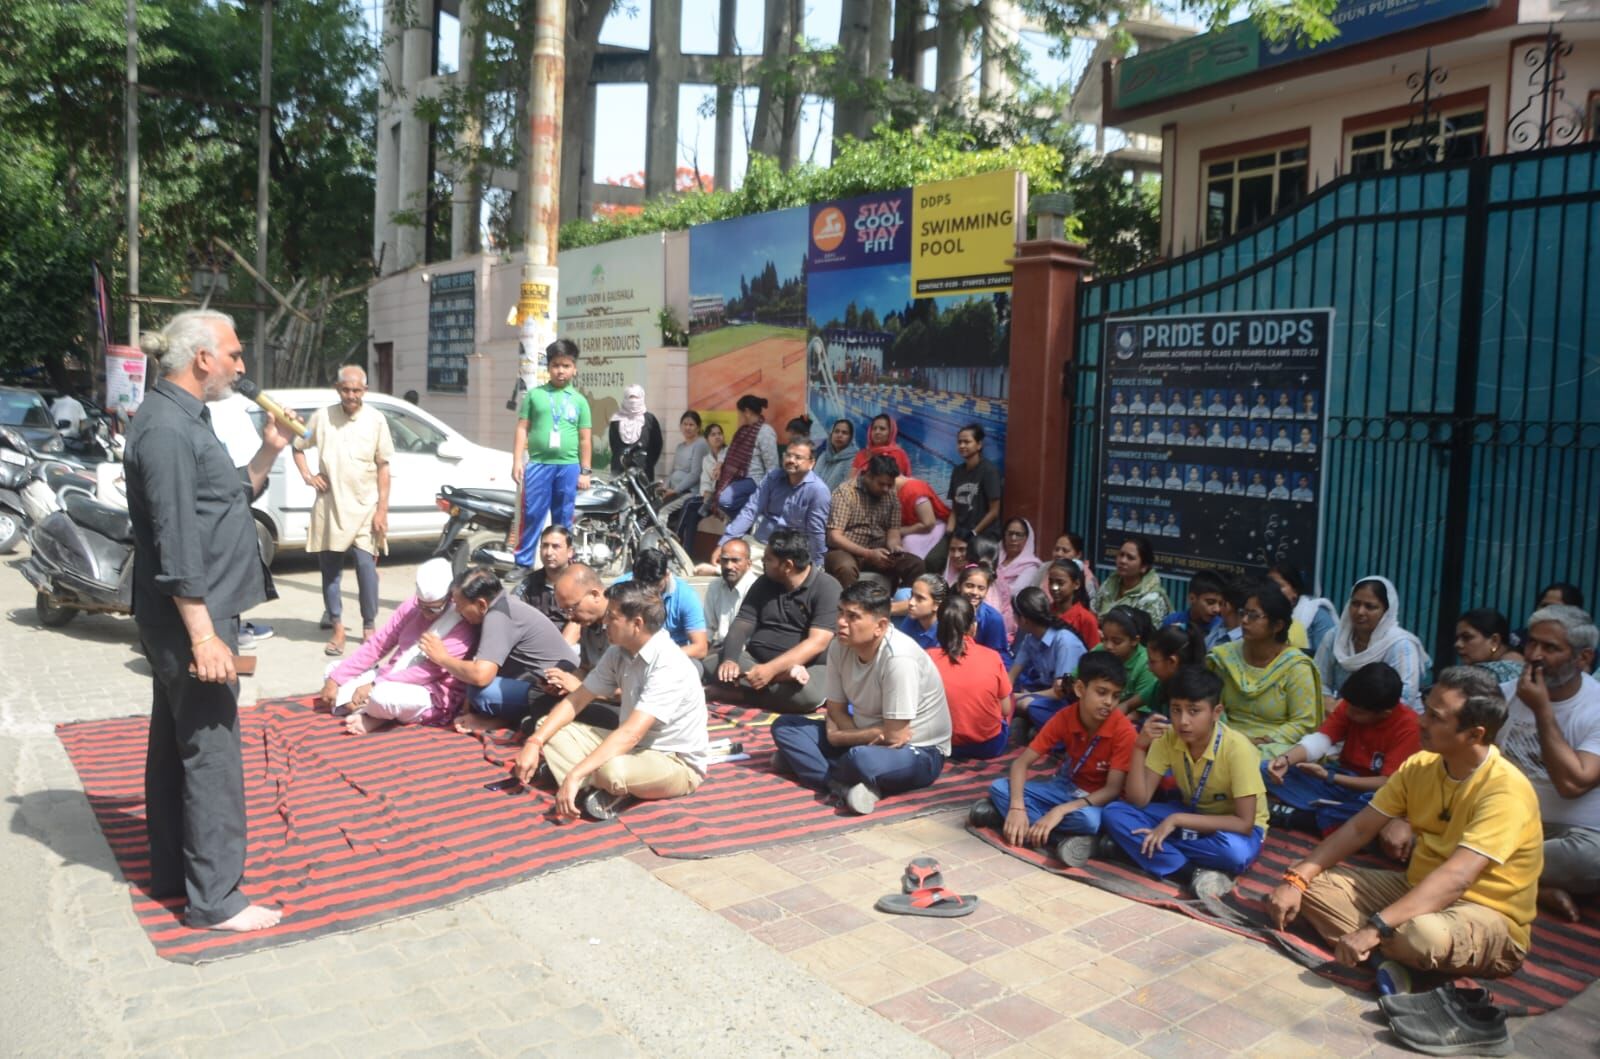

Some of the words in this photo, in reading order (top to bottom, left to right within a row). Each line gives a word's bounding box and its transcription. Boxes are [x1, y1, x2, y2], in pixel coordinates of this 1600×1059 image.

[859, 200, 902, 217] STAY
[920, 193, 951, 209] DDPS
[854, 212, 904, 231] COOL
[920, 210, 1013, 237] SWIMMING
[857, 225, 900, 243] STAY
[864, 237, 894, 253] FIT!
[920, 238, 965, 257] POOL
[1142, 322, 1205, 348] PRIDE
[1212, 321, 1241, 346] OF
[1248, 319, 1314, 345] DDPS
[583, 336, 601, 352] FARM
[602, 334, 640, 351] PRODUCTS
